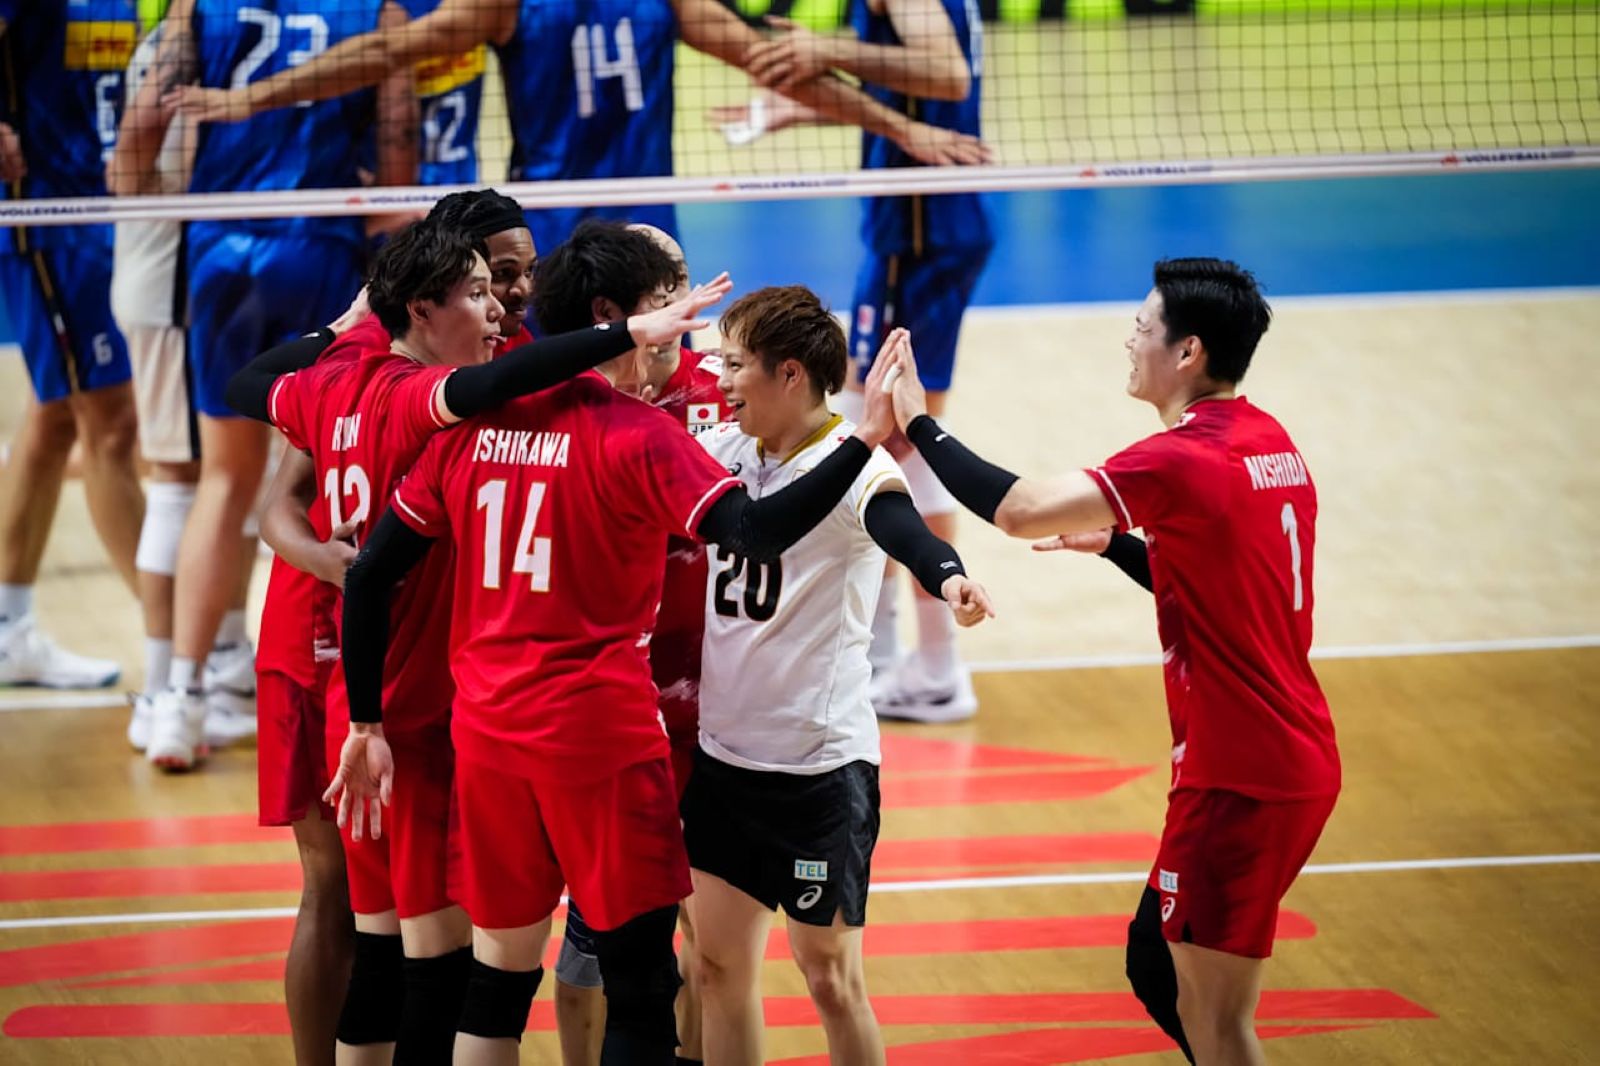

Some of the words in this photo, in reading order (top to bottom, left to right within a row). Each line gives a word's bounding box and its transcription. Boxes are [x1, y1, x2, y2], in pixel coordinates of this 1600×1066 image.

[571, 17, 645, 118] 14
[424, 92, 468, 162] 12
[92, 332, 113, 367] 6
[331, 412, 362, 452] RN
[472, 428, 570, 468] ISHIKAWA
[1242, 451, 1309, 491] NISHIDA
[476, 479, 552, 593] 14
[1281, 502, 1303, 612] 1
[714, 545, 782, 621] 20
[796, 862, 826, 878] TEL
